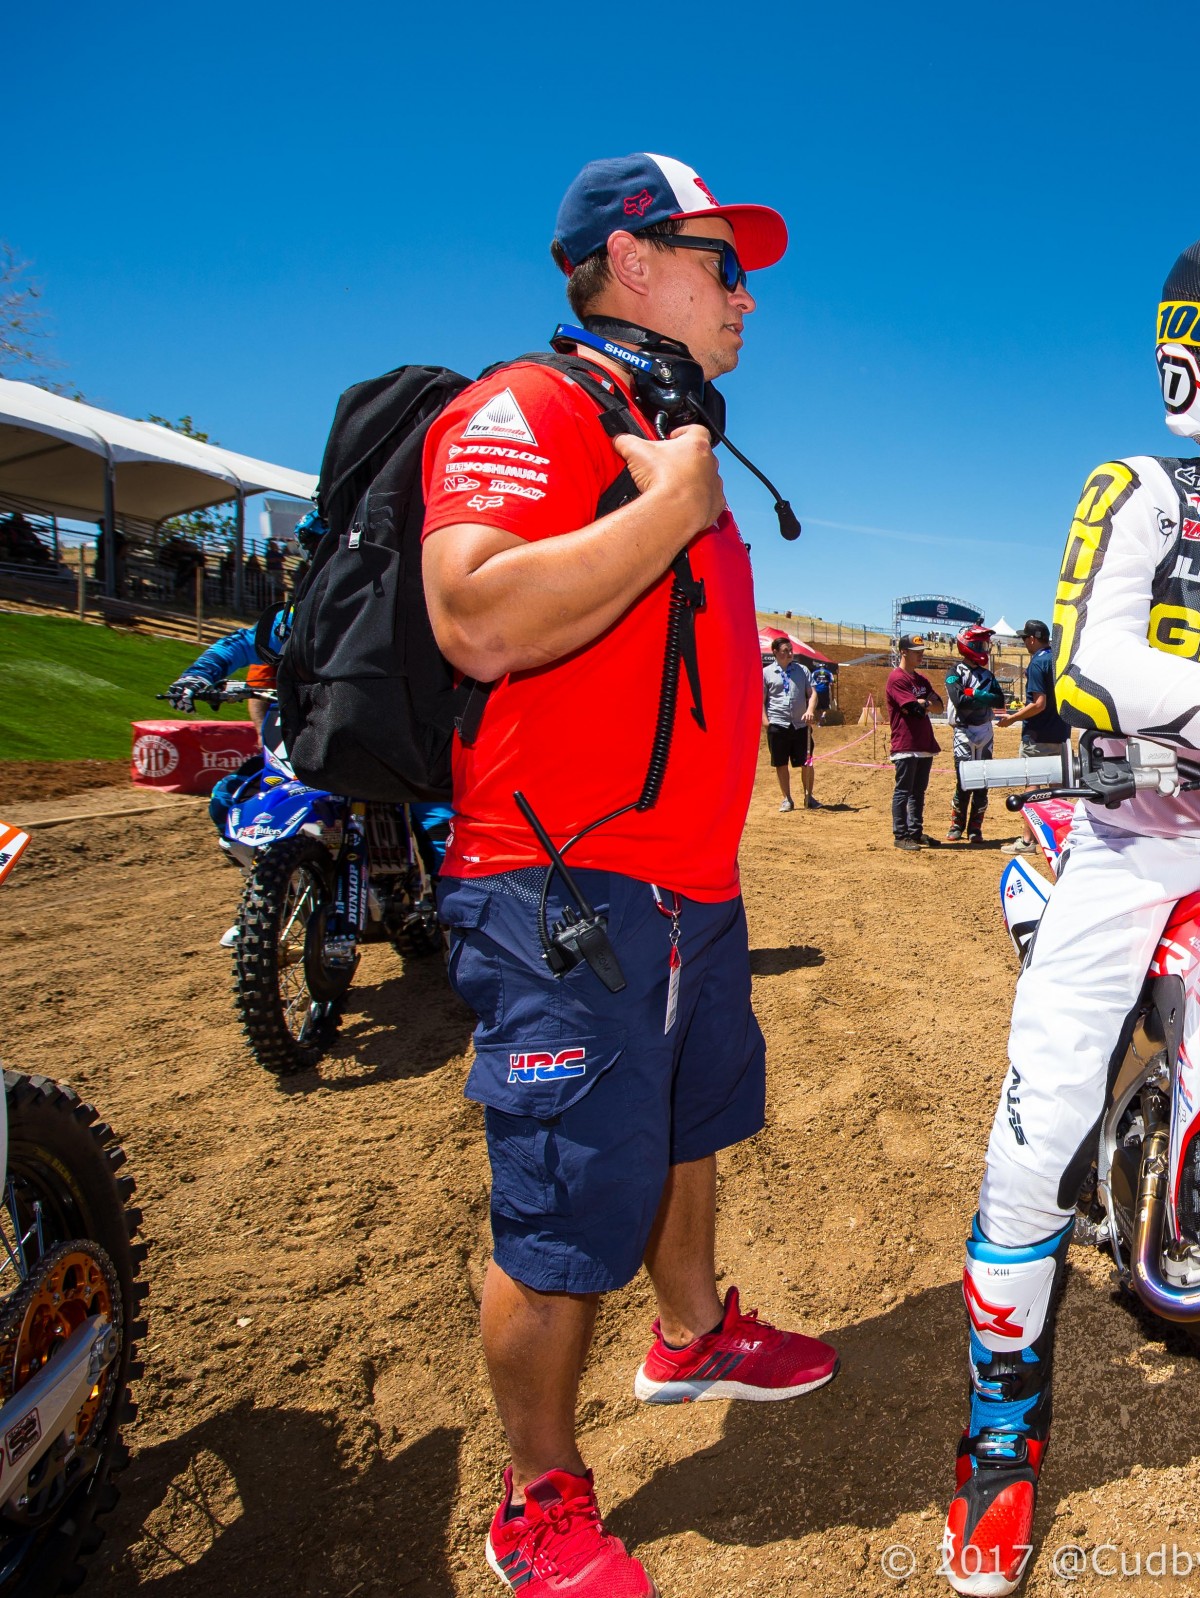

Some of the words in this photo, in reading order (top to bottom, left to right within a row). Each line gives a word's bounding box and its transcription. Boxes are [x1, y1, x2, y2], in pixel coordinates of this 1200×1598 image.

[604, 343, 649, 369] SHORT
[471, 424, 489, 432] Pro
[491, 426, 526, 436] Honda
[463, 445, 550, 465] DUNLOP
[464, 462, 548, 484] YOSHIMURA
[348, 864, 359, 925] DUNLOP
[508, 1047, 586, 1083] HRC
[987, 1268, 1010, 1277] LXIII
